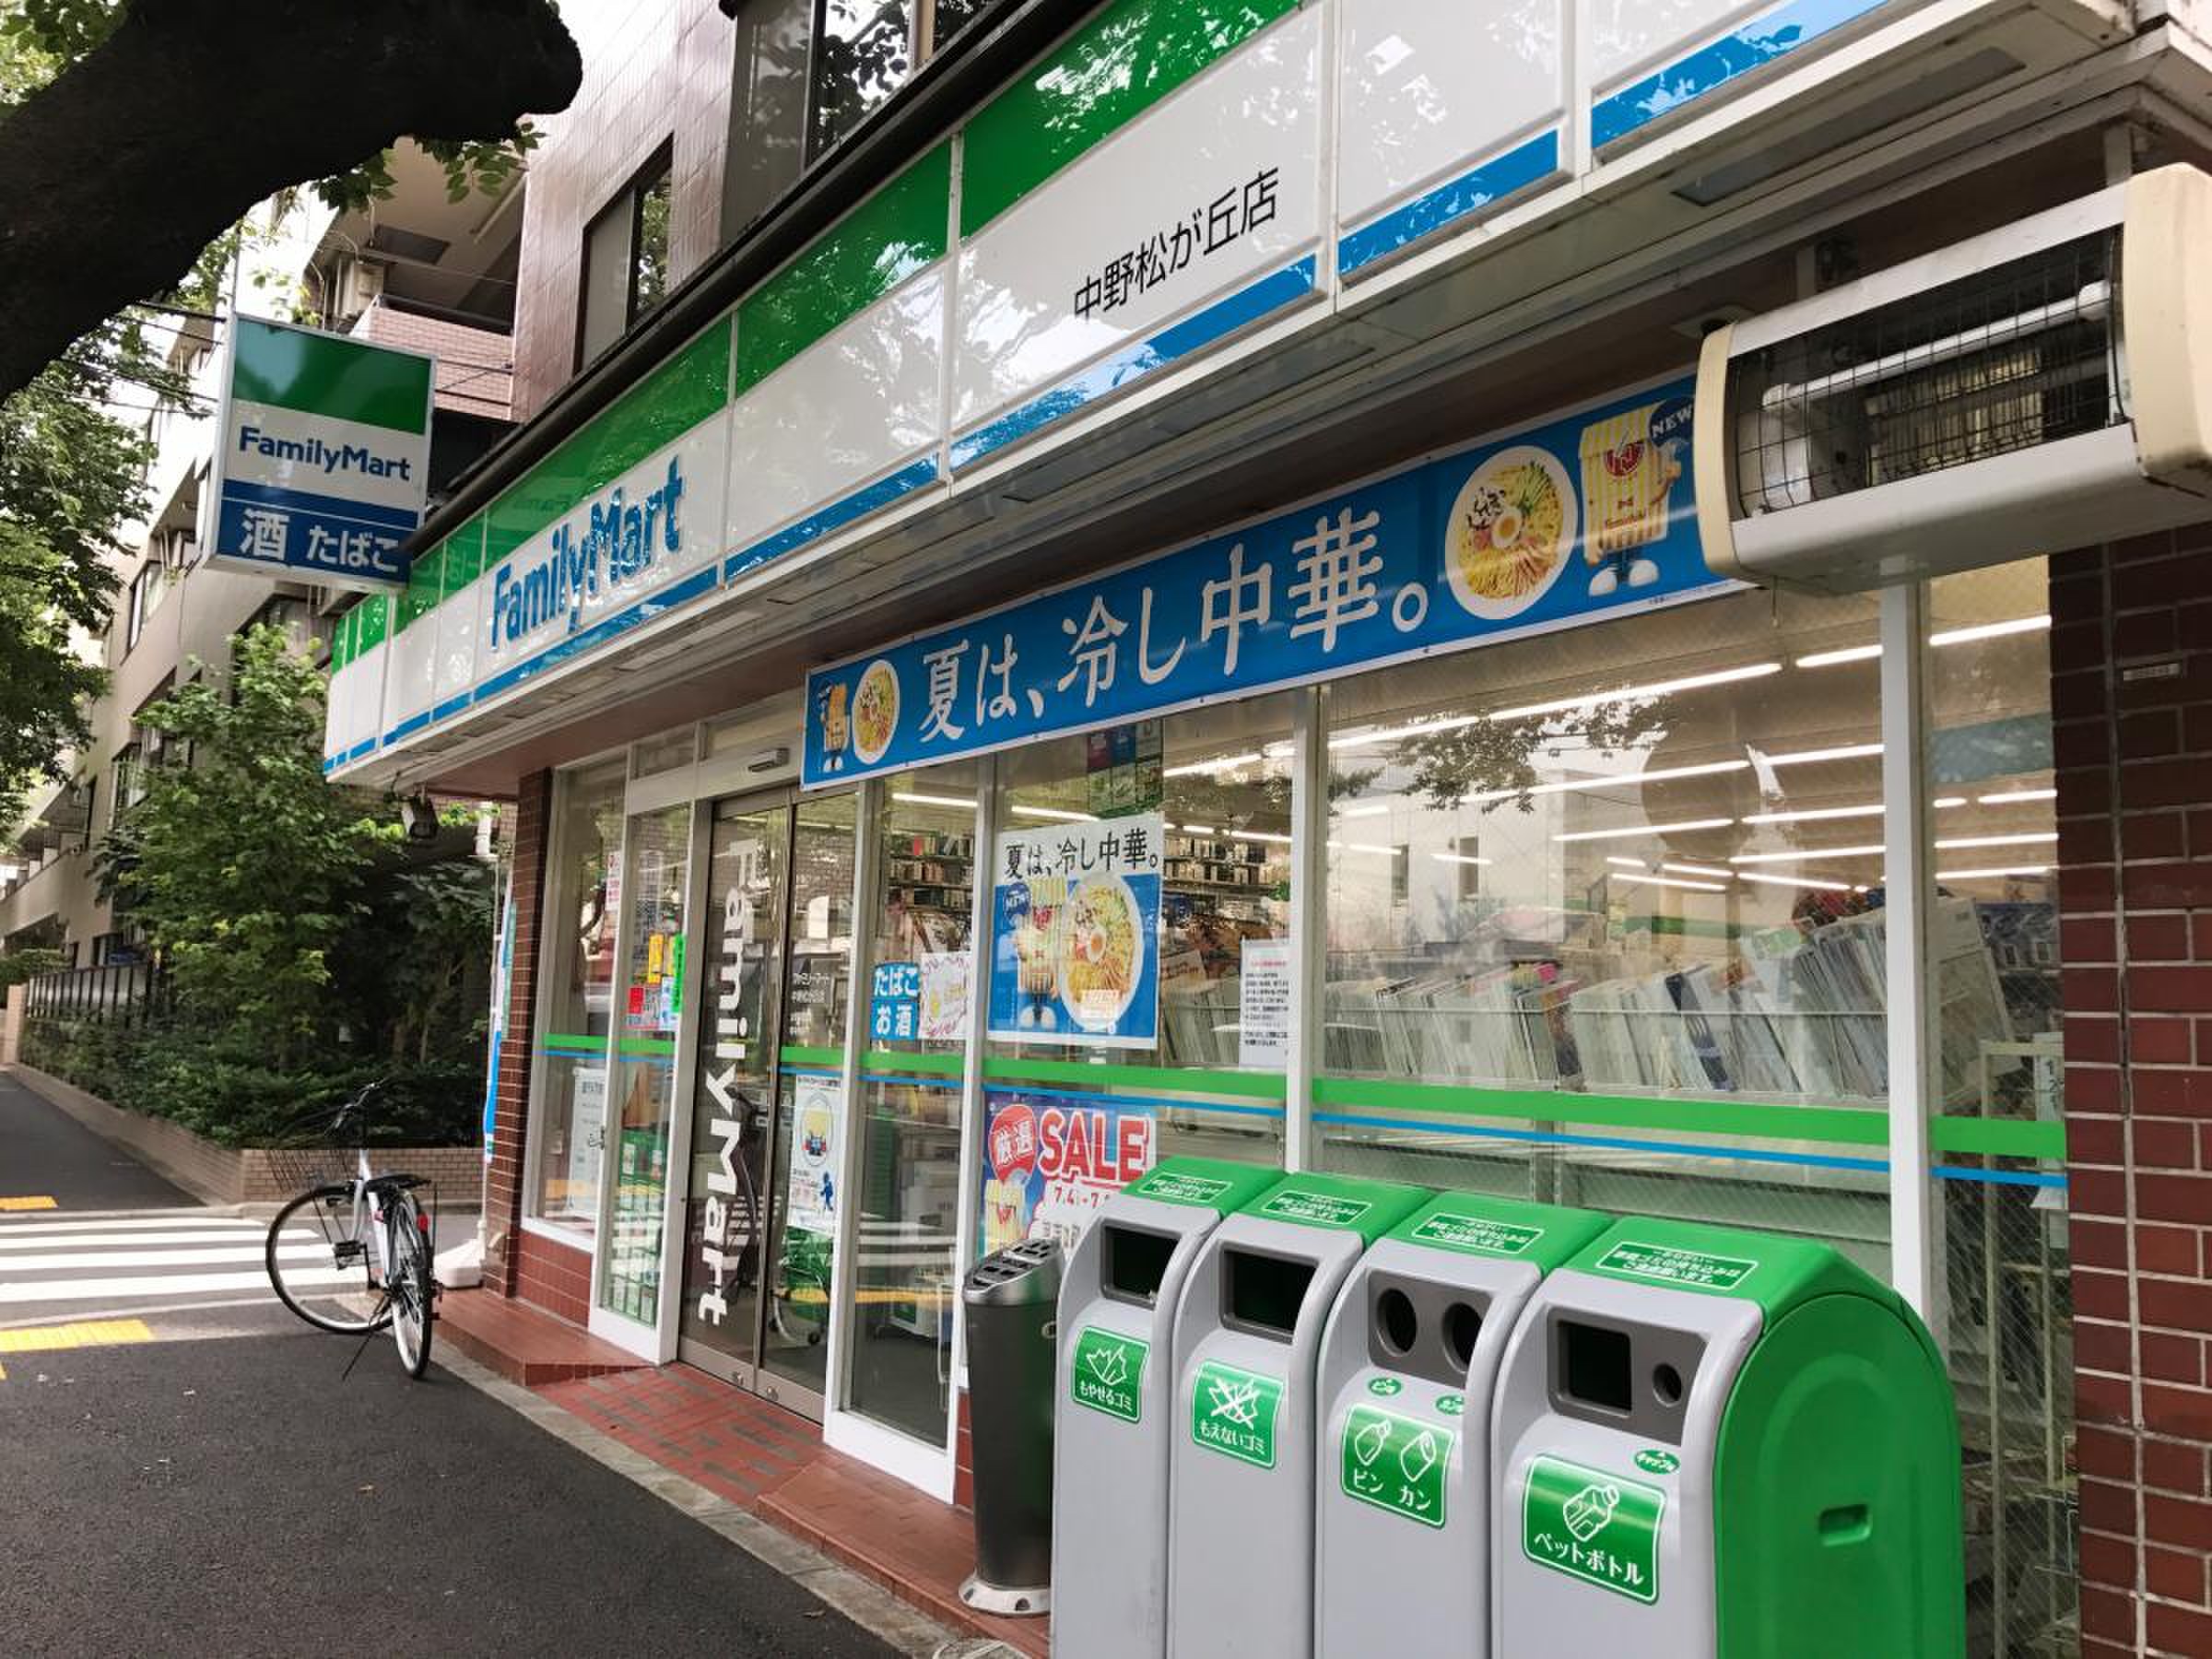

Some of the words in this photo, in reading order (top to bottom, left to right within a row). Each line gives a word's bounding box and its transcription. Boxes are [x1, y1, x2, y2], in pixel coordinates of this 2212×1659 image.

[1073, 167, 1278, 324] 中野松が丘店
[1652, 406, 1694, 438] NEW
[239, 427, 410, 482] FamilyMart
[240, 508, 288, 560] 酒
[306, 526, 399, 574] たばこ
[491, 455, 685, 651] FamilyMart
[919, 506, 1428, 743] 夏は、冷し中華。
[1005, 828, 1158, 879] 夏は、冷し中華。
[874, 967, 918, 995] たばこ
[698, 839, 757, 1325] FamilyMart
[1038, 1109, 1147, 1182] SALE
[1079, 1380, 1133, 1411] もやせるゴミ
[1200, 1419, 1265, 1455] もえないゴミ
[1399, 1485, 1431, 1510] カン
[1534, 1533, 1644, 1585] ペットボトル
